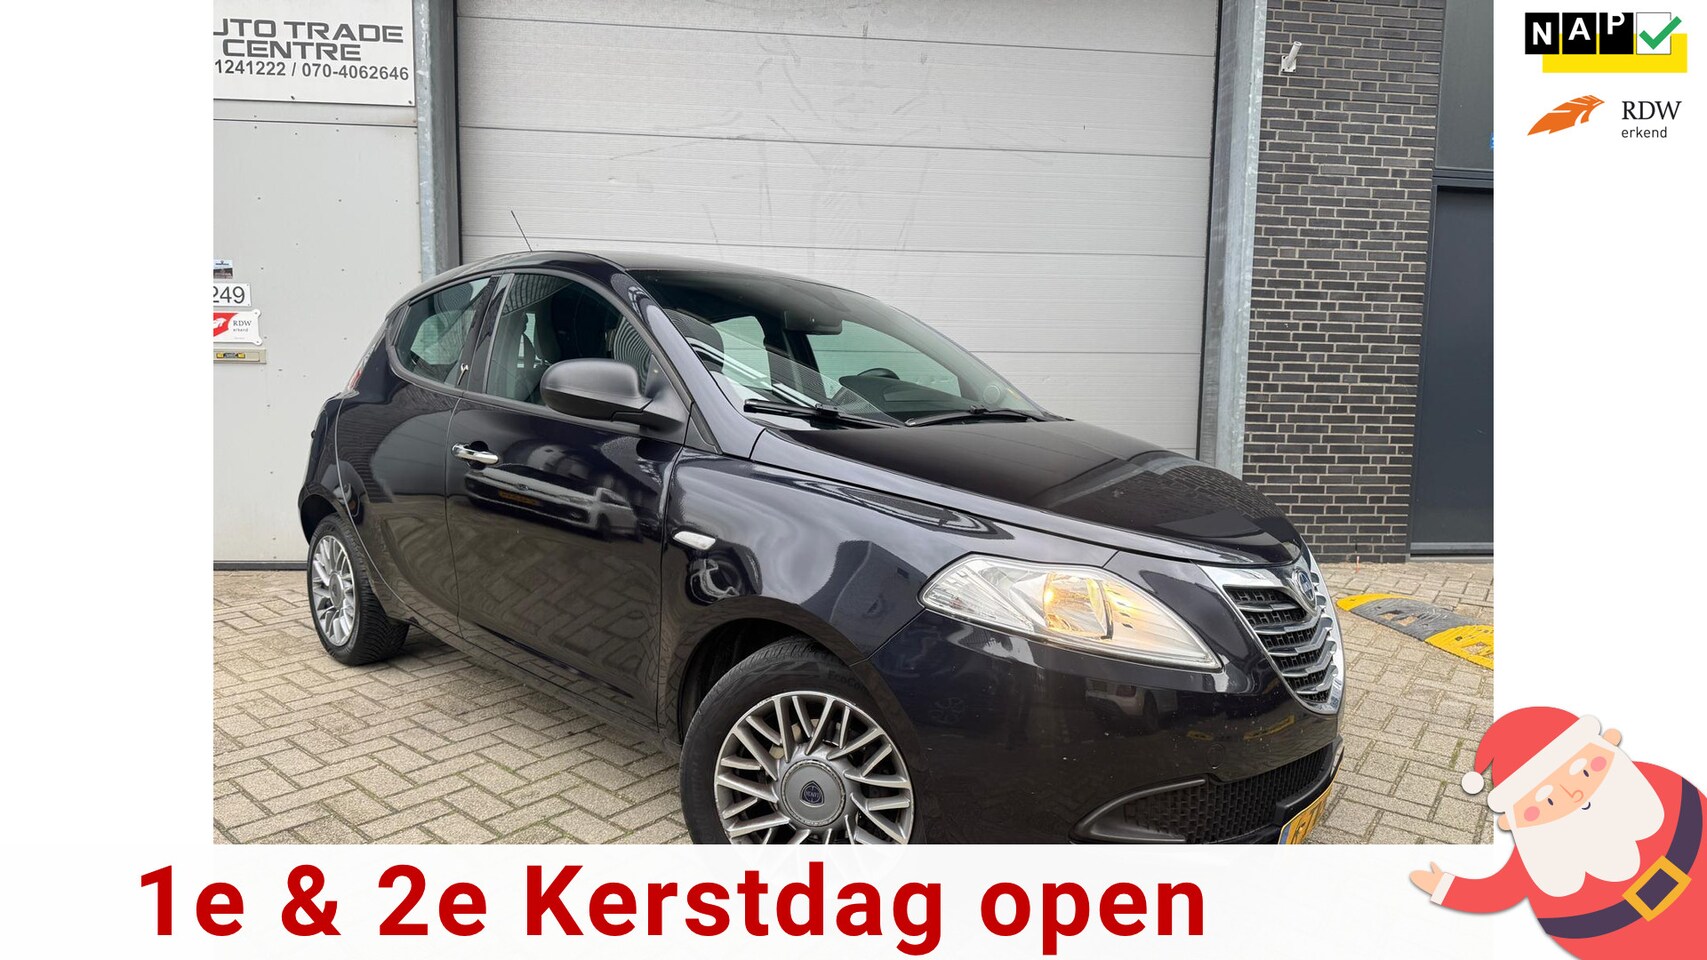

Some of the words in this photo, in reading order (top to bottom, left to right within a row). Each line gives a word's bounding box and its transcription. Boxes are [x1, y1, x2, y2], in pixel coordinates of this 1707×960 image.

[284, 21, 404, 43] TRADE
[222, 39, 362, 61] CENTRE
[214, 59, 286, 76] 1241222
[291, 62, 297, 77] /
[301, 63, 409, 81] 070-4062646
